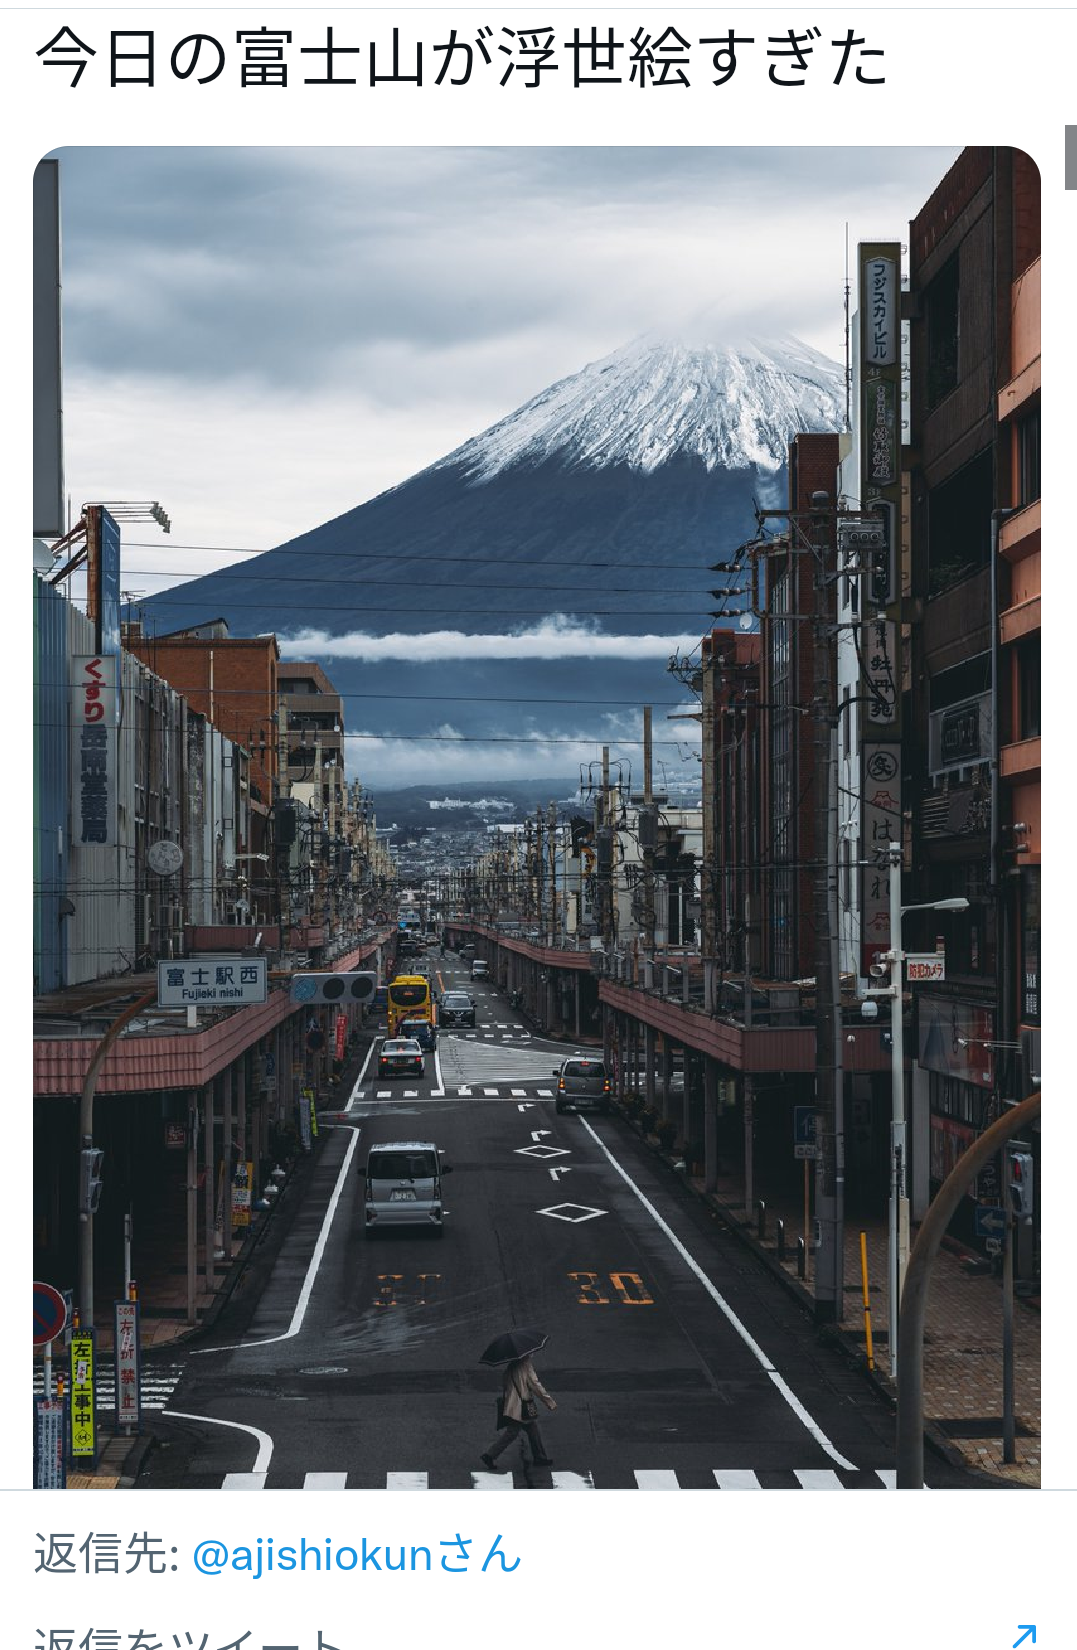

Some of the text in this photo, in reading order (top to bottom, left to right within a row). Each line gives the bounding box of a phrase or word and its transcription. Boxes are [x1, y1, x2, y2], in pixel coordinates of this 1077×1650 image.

[872, 263, 887, 359] フジスカイビル
[80, 658, 106, 723] くすり
[166, 966, 259, 987] 富士駅西
[909, 963, 943, 979] 防犯カメラ
[220, 988, 243, 998] nishi
[566, 1272, 654, 1304] 30
